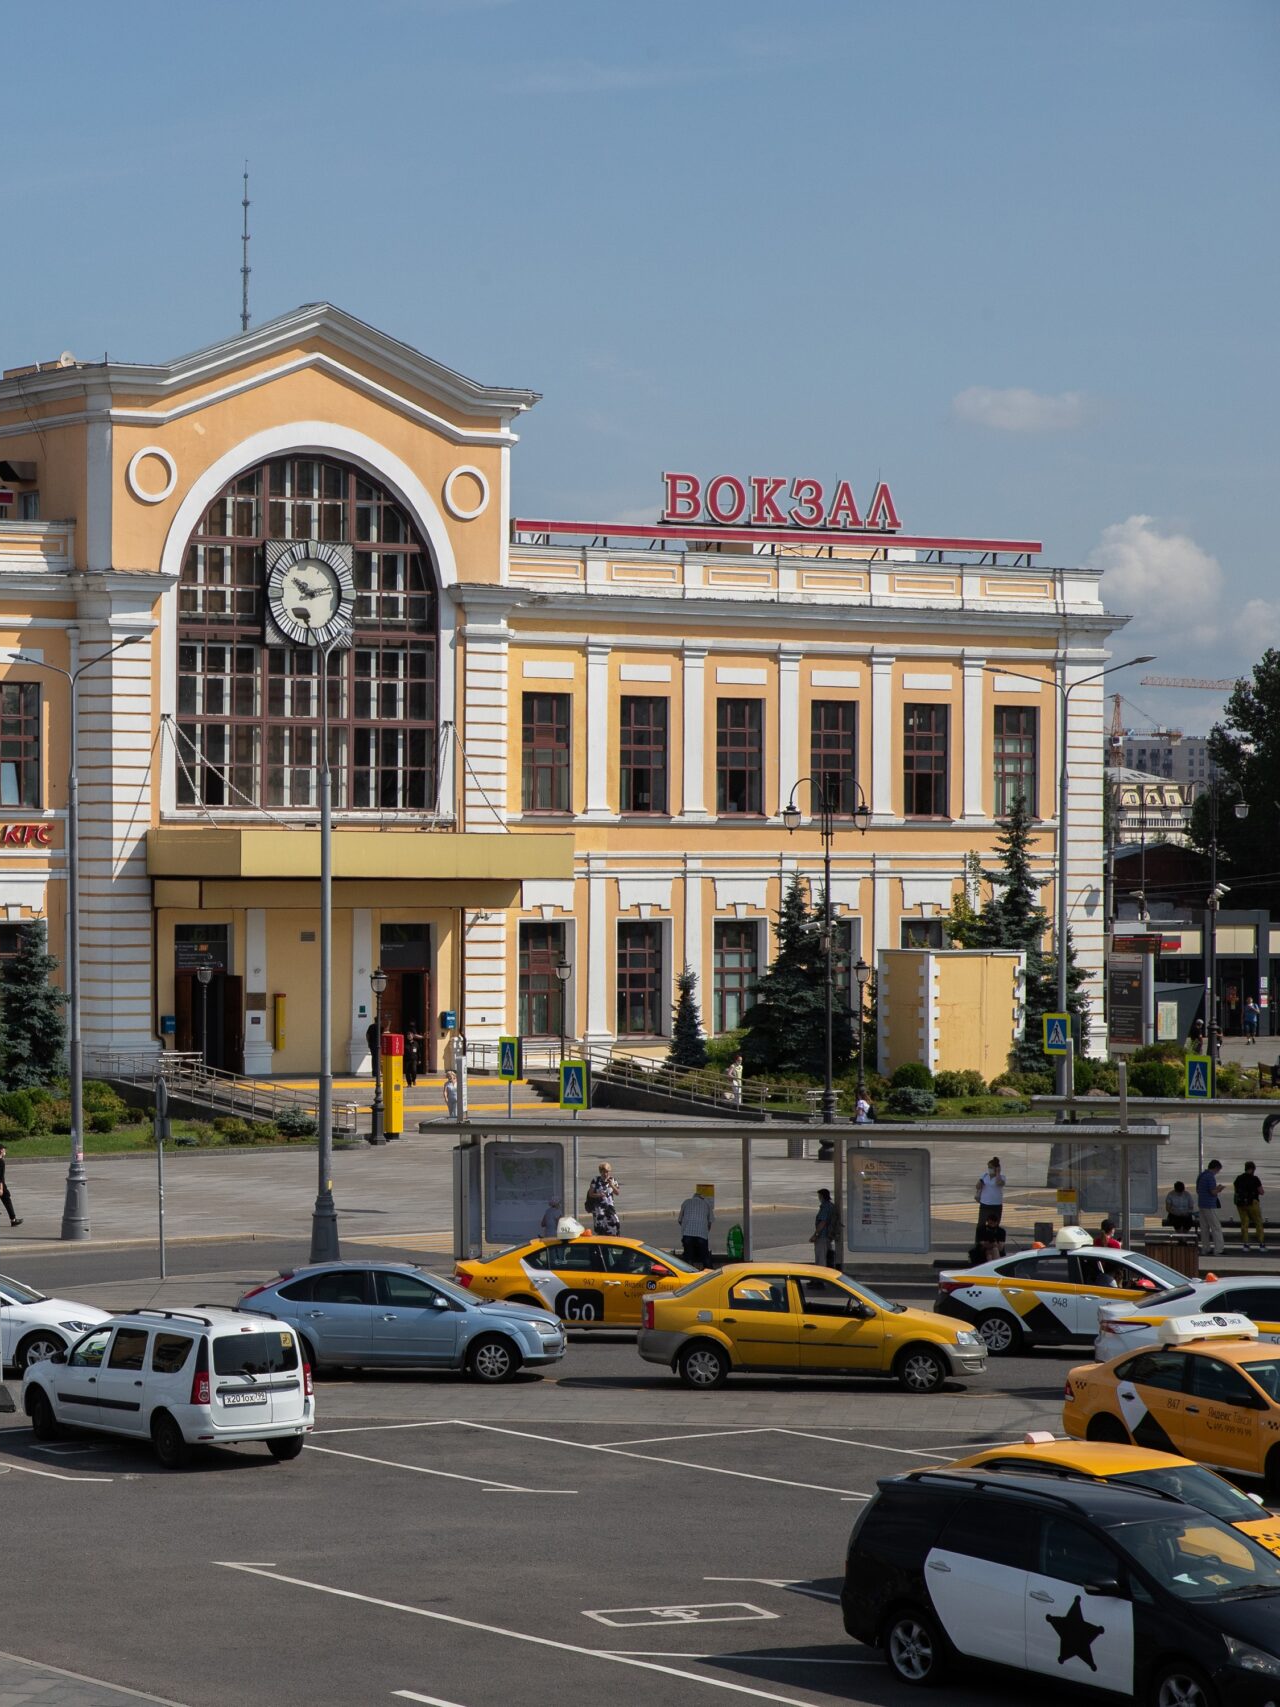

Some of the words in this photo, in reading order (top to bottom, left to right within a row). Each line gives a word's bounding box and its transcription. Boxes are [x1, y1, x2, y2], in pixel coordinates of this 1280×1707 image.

[663, 471, 902, 529] ВОКЗАЛ
[4, 823, 55, 844] KFC
[564, 1294, 595, 1321] Go
[1052, 1296, 1068, 1308] 948
